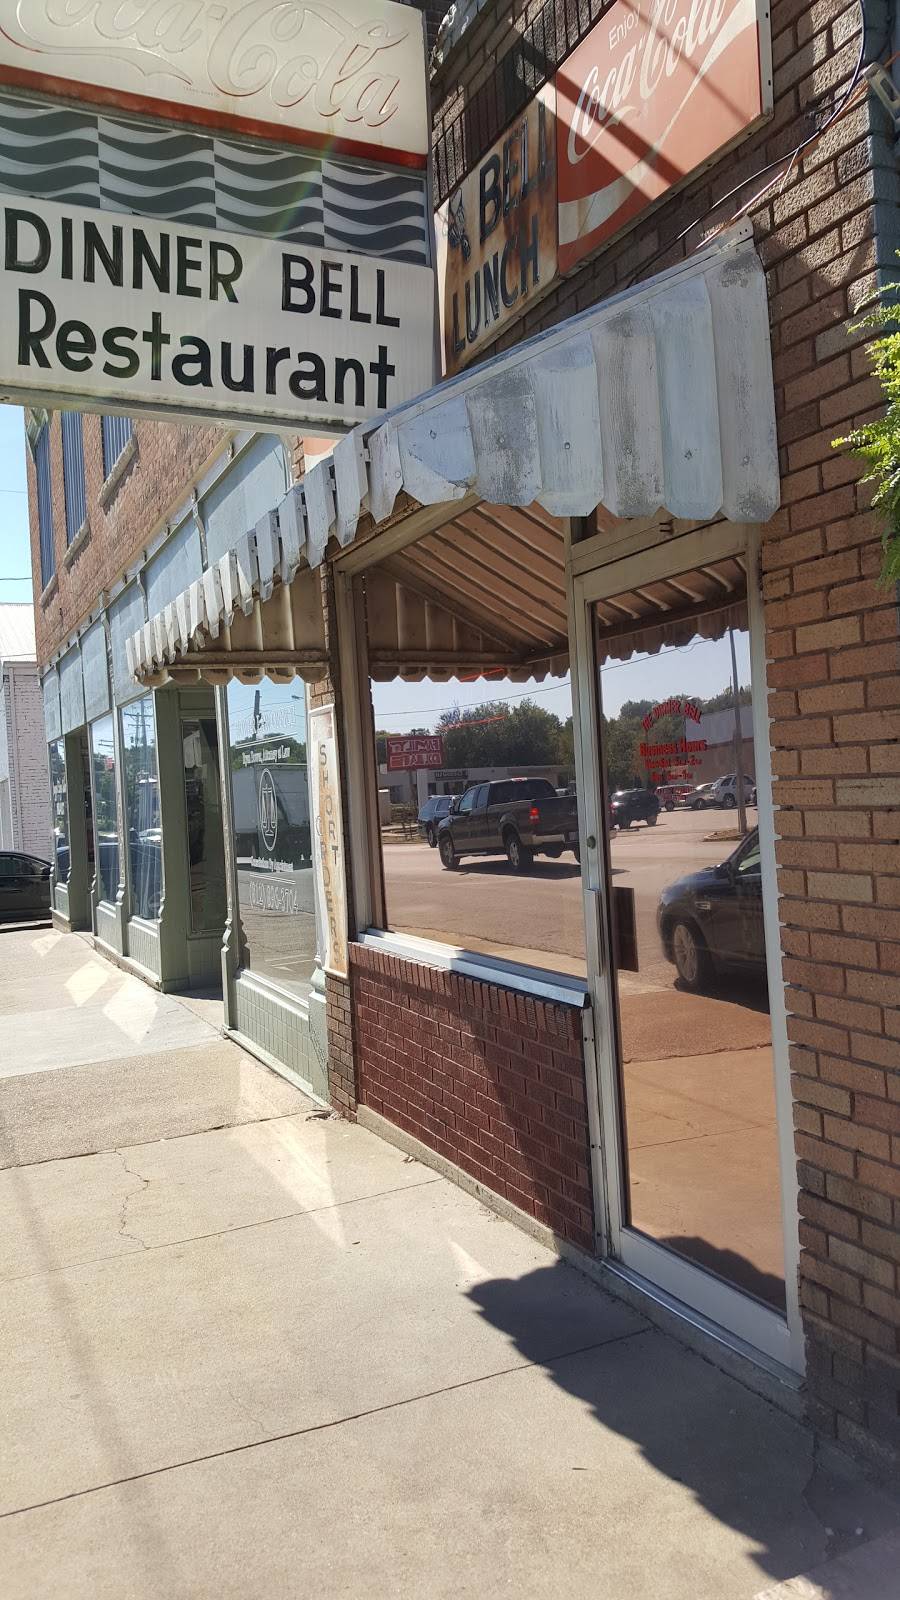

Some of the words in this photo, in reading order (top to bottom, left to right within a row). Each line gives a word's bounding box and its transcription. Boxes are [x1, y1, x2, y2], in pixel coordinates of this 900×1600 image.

[608, 4, 641, 50] Enjoy
[480, 98, 552, 241] BELL
[4, 207, 243, 303] DINNER
[281, 252, 400, 328] BELL
[453, 213, 540, 351] LUNCH
[18, 288, 396, 409] Restaurant
[319, 744, 340, 865] SHORT
